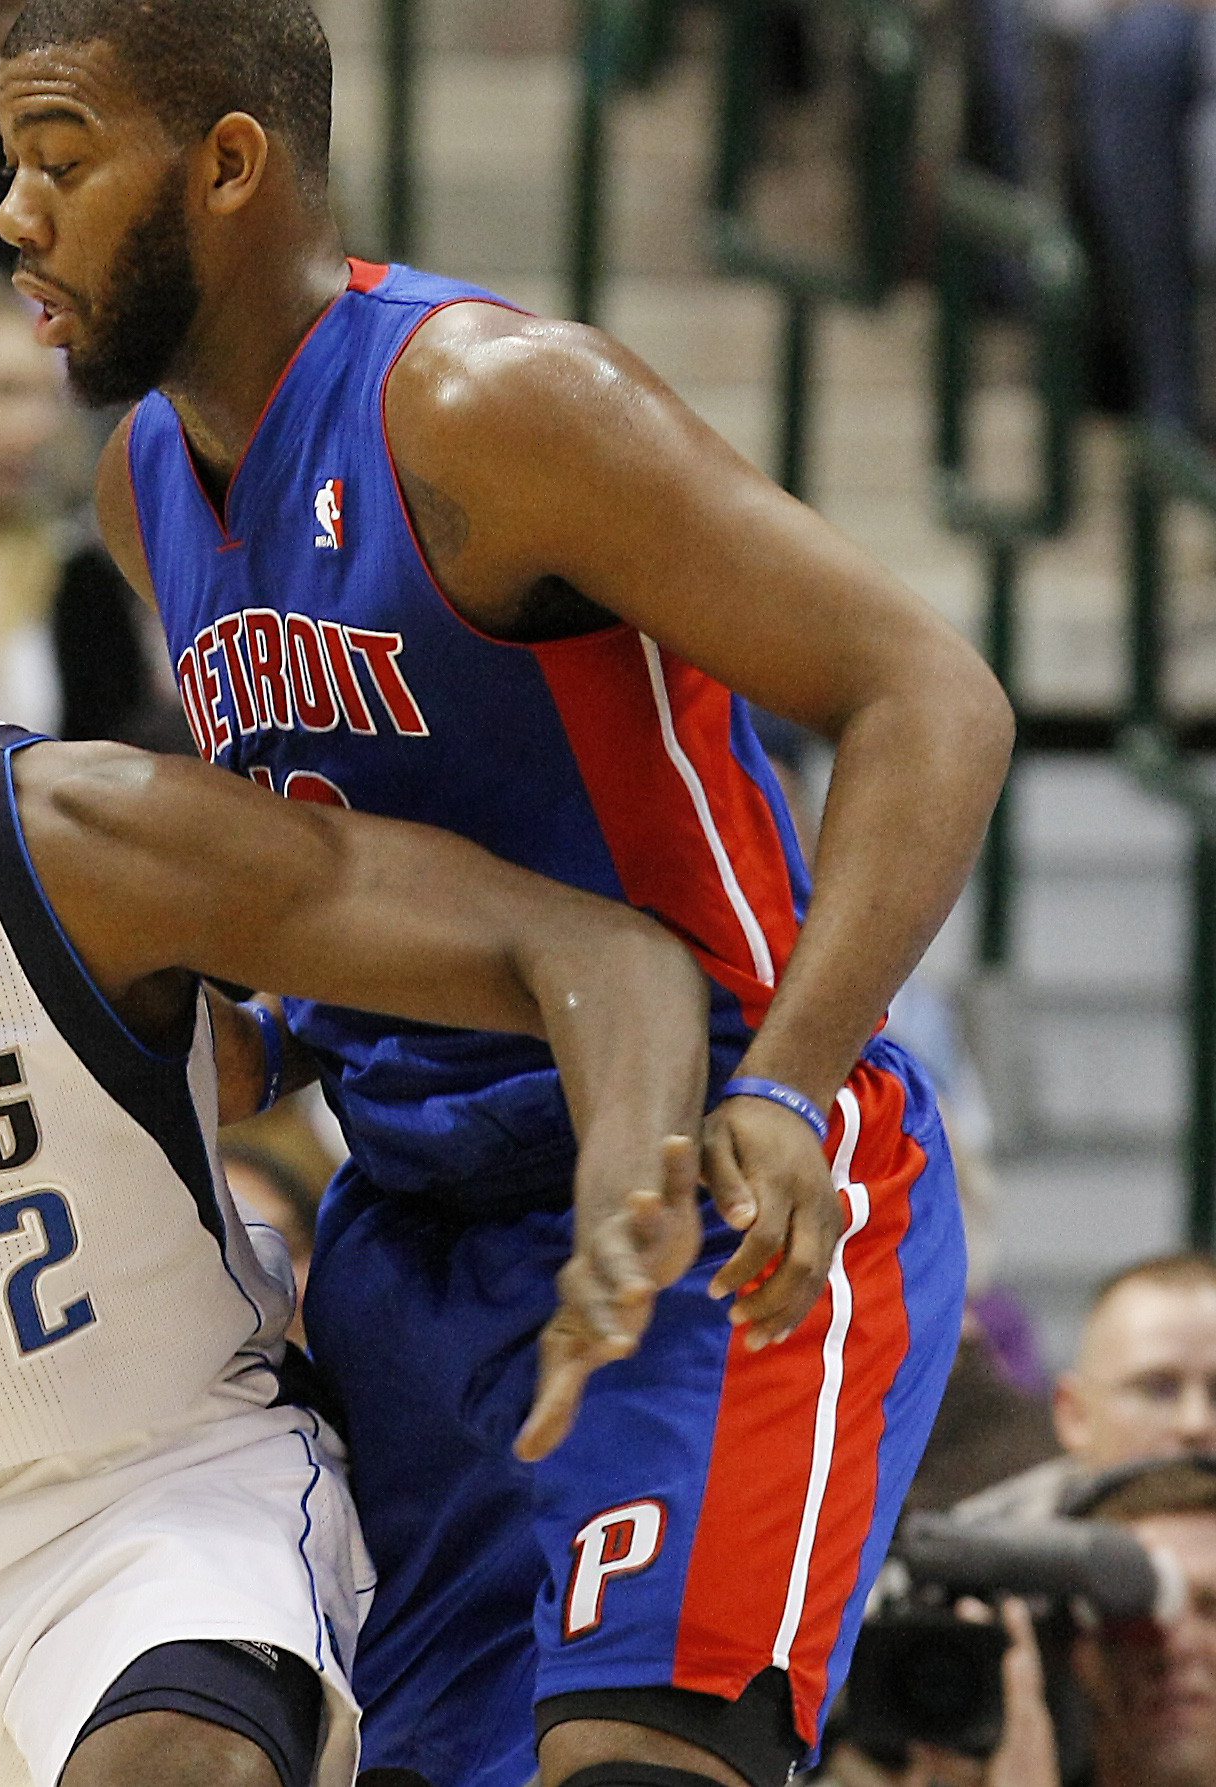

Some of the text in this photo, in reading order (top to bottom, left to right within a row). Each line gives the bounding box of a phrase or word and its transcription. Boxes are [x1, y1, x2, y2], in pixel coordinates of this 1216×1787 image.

[315, 535, 333, 548] NBA
[177, 608, 430, 764] DETROIT
[560, 1497, 668, 1644] P
